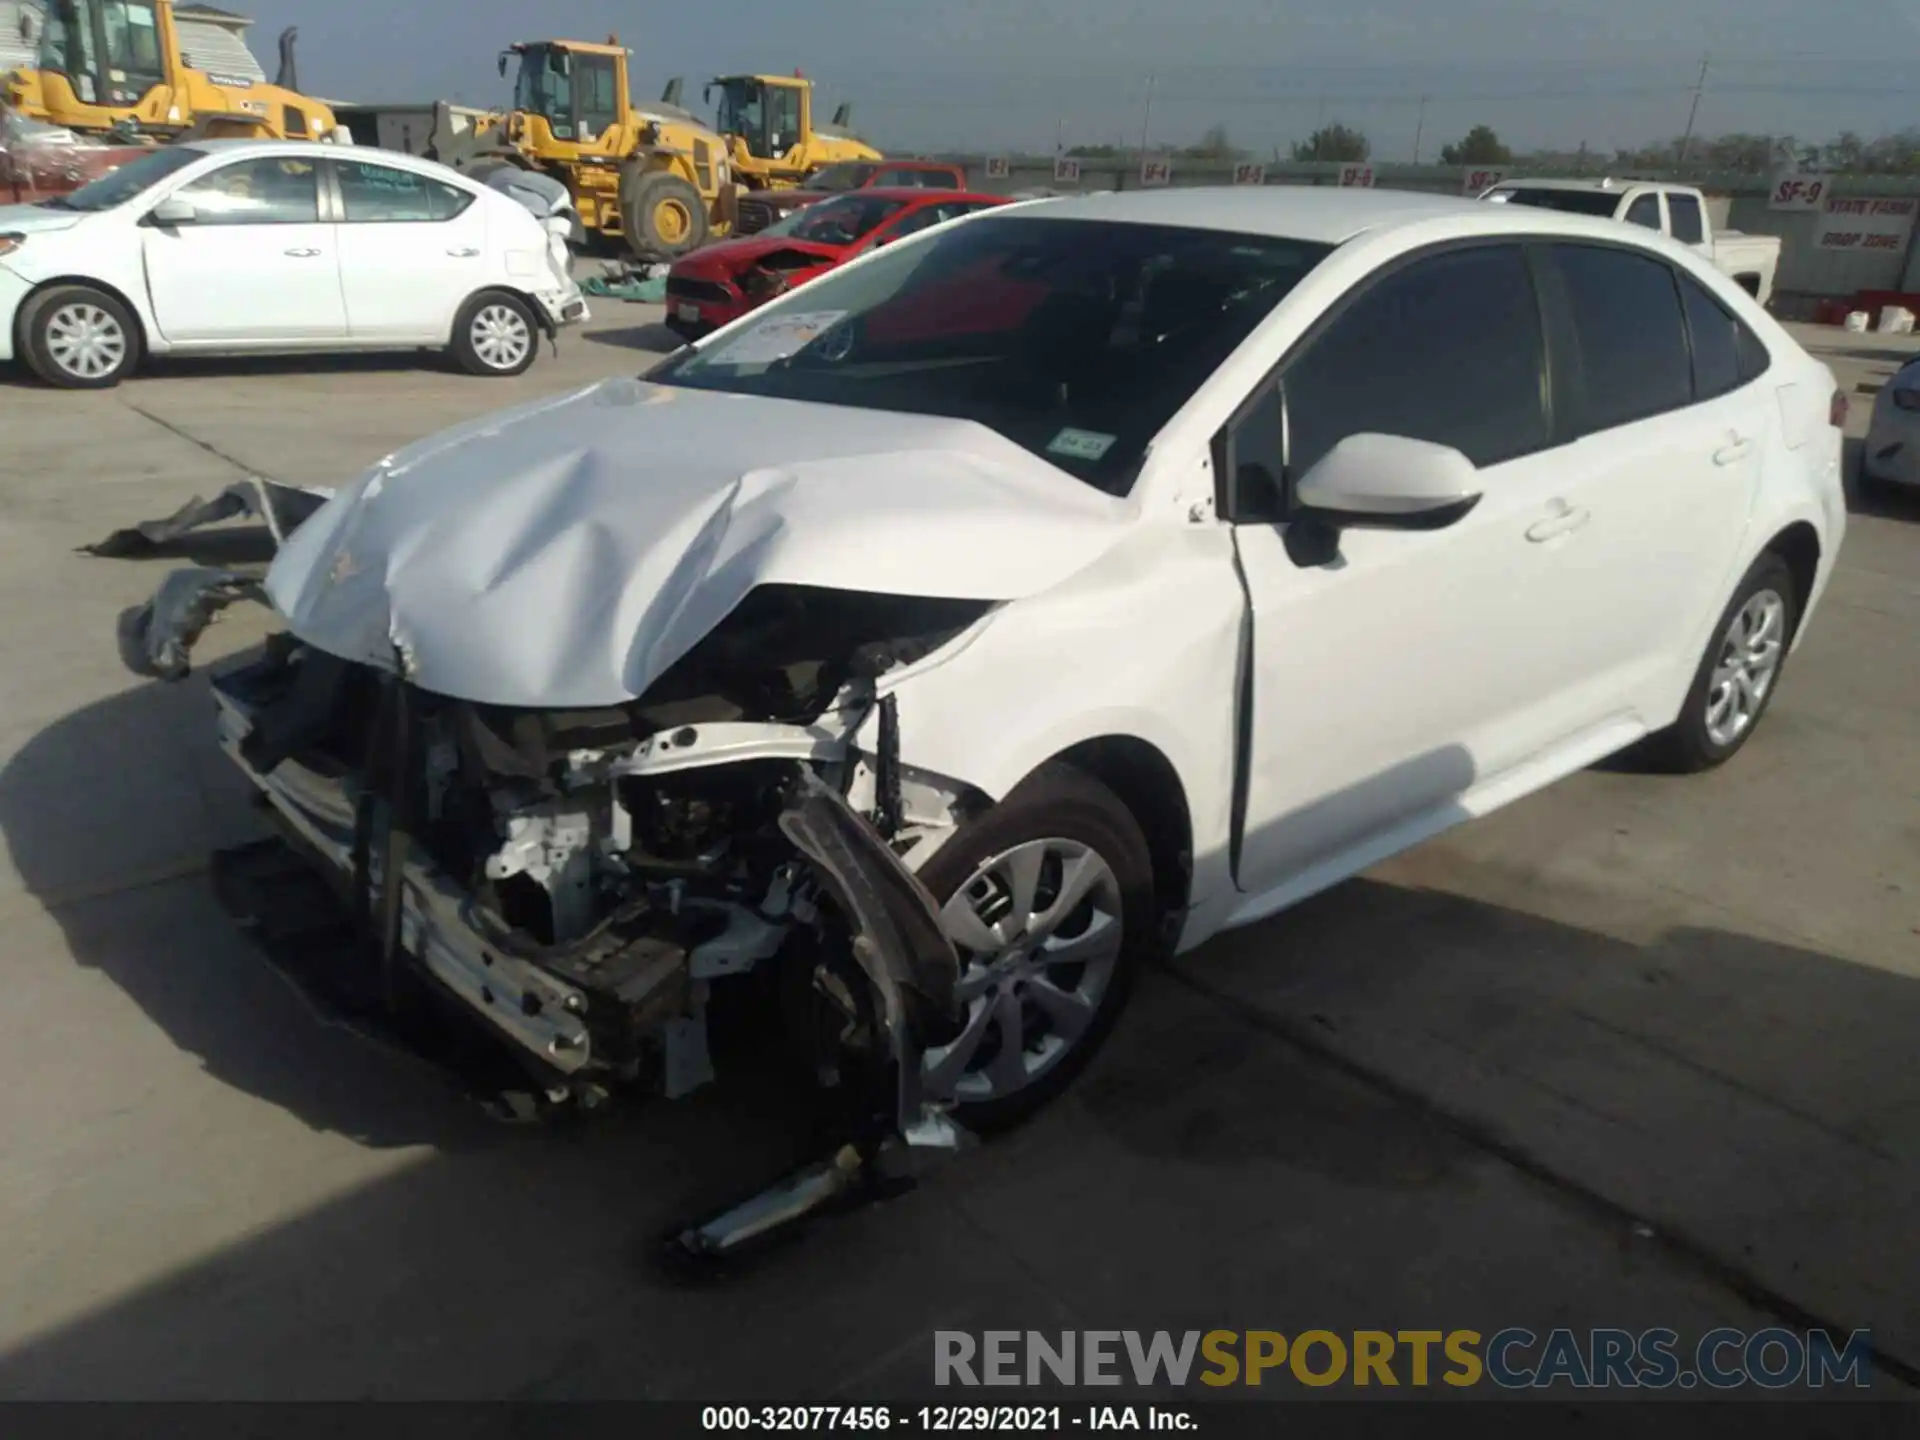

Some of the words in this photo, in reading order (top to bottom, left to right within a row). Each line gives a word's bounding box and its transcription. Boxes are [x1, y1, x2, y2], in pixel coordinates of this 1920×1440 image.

[1775, 179, 1823, 204] SF-9
[1827, 200, 1869, 215] STATE
[1871, 200, 1913, 215] FARM
[1821, 231, 1861, 247] DROP
[1862, 233, 1900, 249] ZONE
